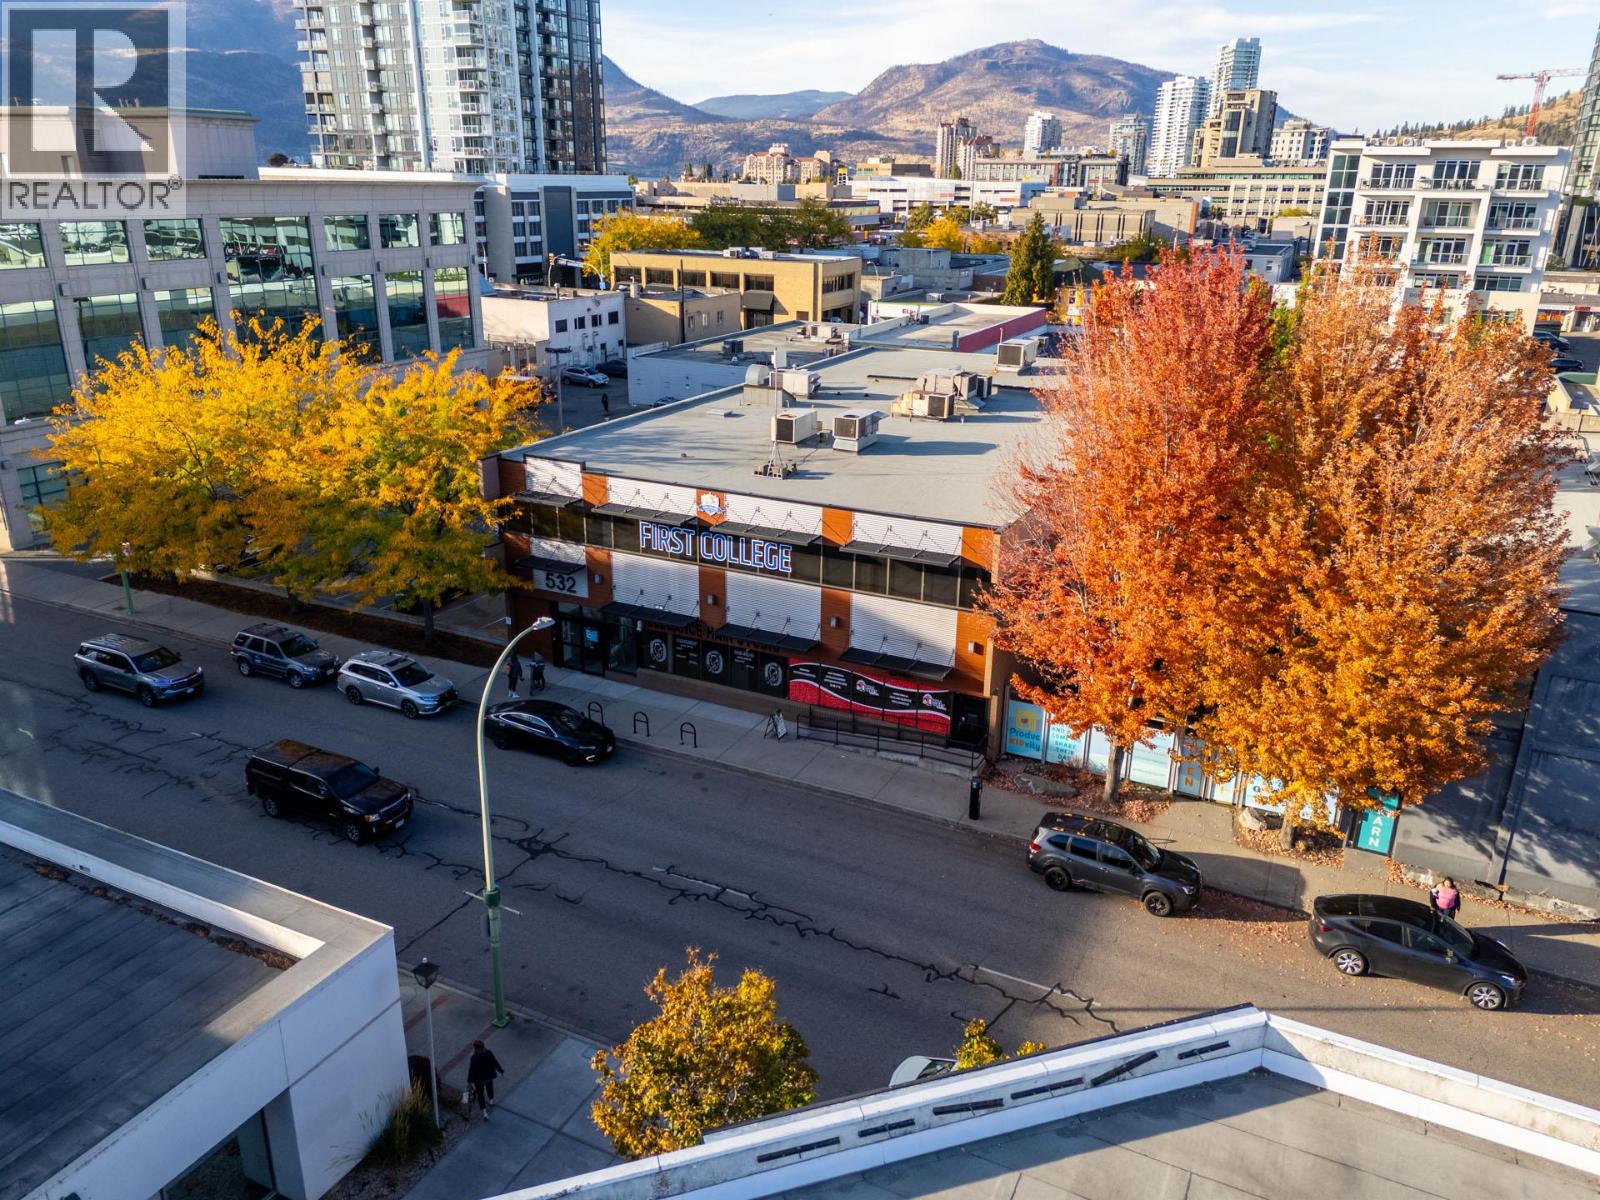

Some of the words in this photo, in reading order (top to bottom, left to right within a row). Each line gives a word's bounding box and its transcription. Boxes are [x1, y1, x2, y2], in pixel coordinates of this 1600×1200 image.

[639, 520, 696, 556] FIRST
[700, 531, 793, 573] COLLEGE
[545, 572, 577, 594] 532
[1368, 816, 1384, 848] ARN
